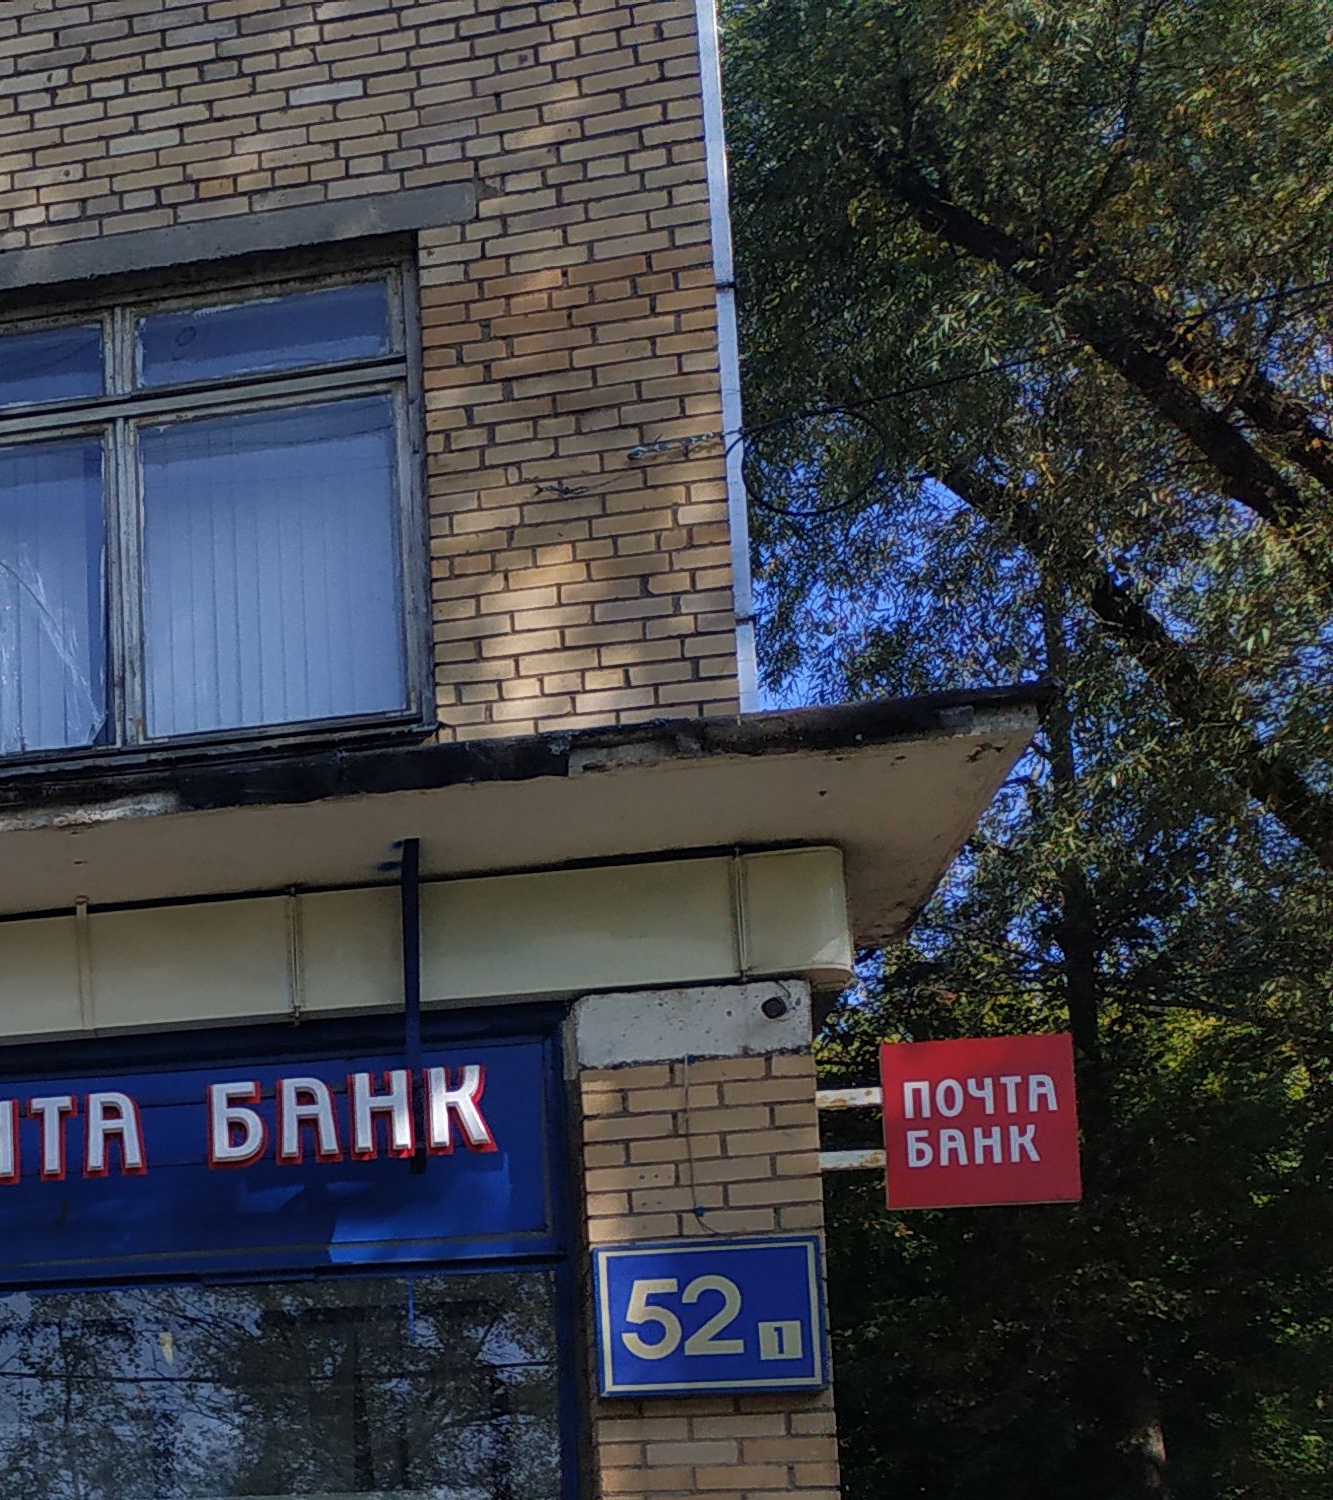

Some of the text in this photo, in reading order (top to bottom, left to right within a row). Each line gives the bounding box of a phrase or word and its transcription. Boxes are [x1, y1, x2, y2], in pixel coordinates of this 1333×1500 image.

[207, 1064, 498, 1170] БАНК
[903, 1074, 1058, 1120] ПОЧТА
[906, 1124, 1041, 1168] БАНК
[621, 1275, 744, 1360] 52
